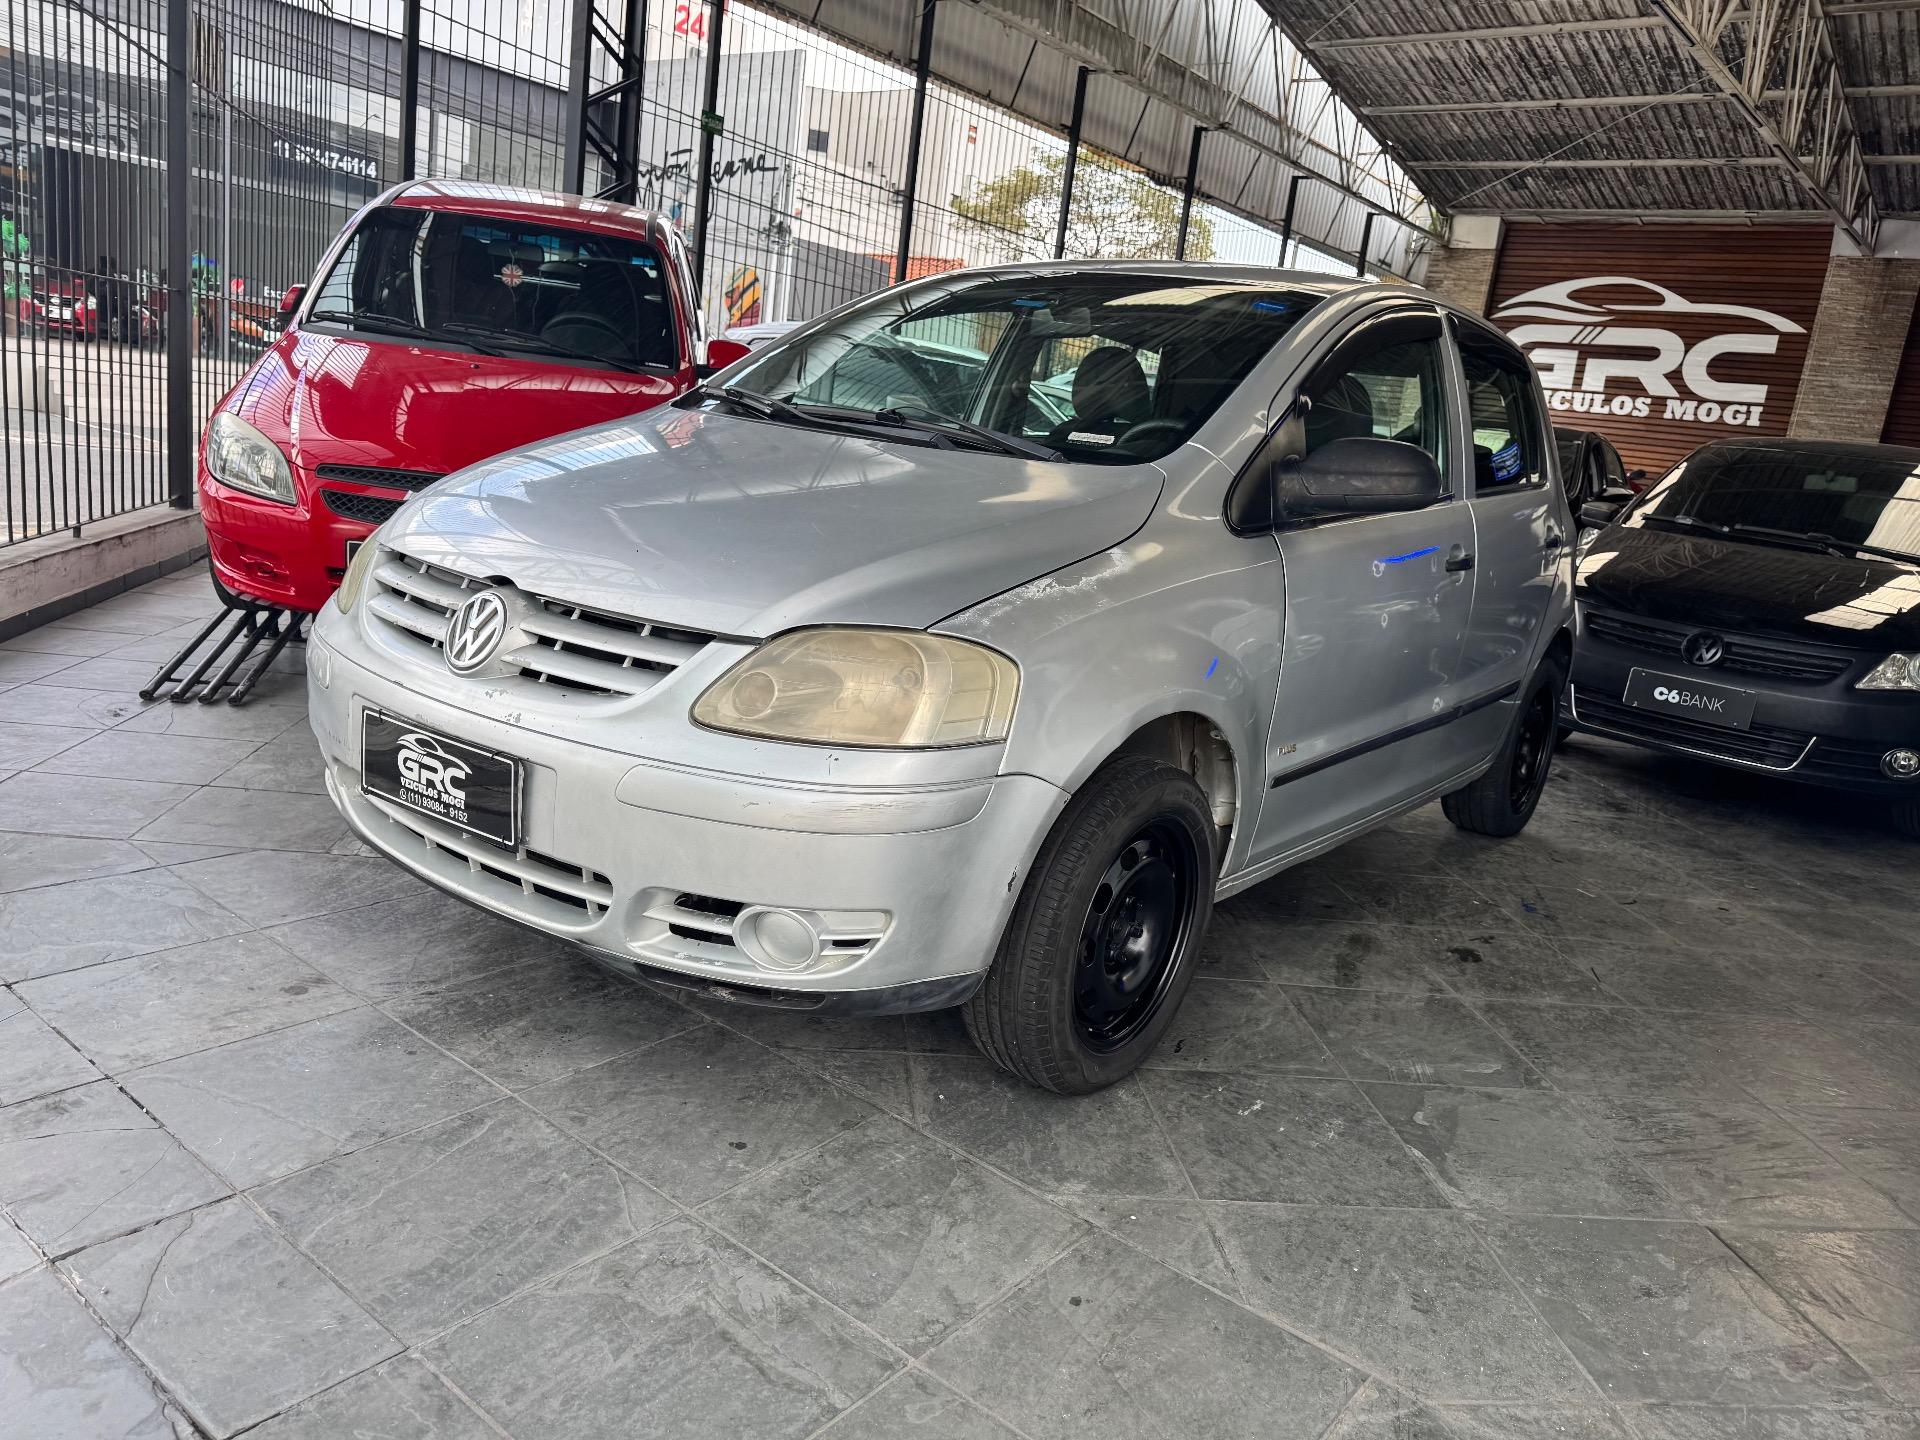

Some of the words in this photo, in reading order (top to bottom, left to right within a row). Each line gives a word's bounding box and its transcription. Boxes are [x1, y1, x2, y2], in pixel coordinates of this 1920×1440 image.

[676, 5, 705, 37] 24
[1506, 324, 1779, 403] GRC
[1663, 398, 1763, 427] MOGI
[397, 748, 466, 800] GRC
[400, 776, 439, 799] VEICULOS
[441, 792, 465, 809] MOGI
[408, 791, 421, 806] (11)
[449, 807, 468, 822] 9152
